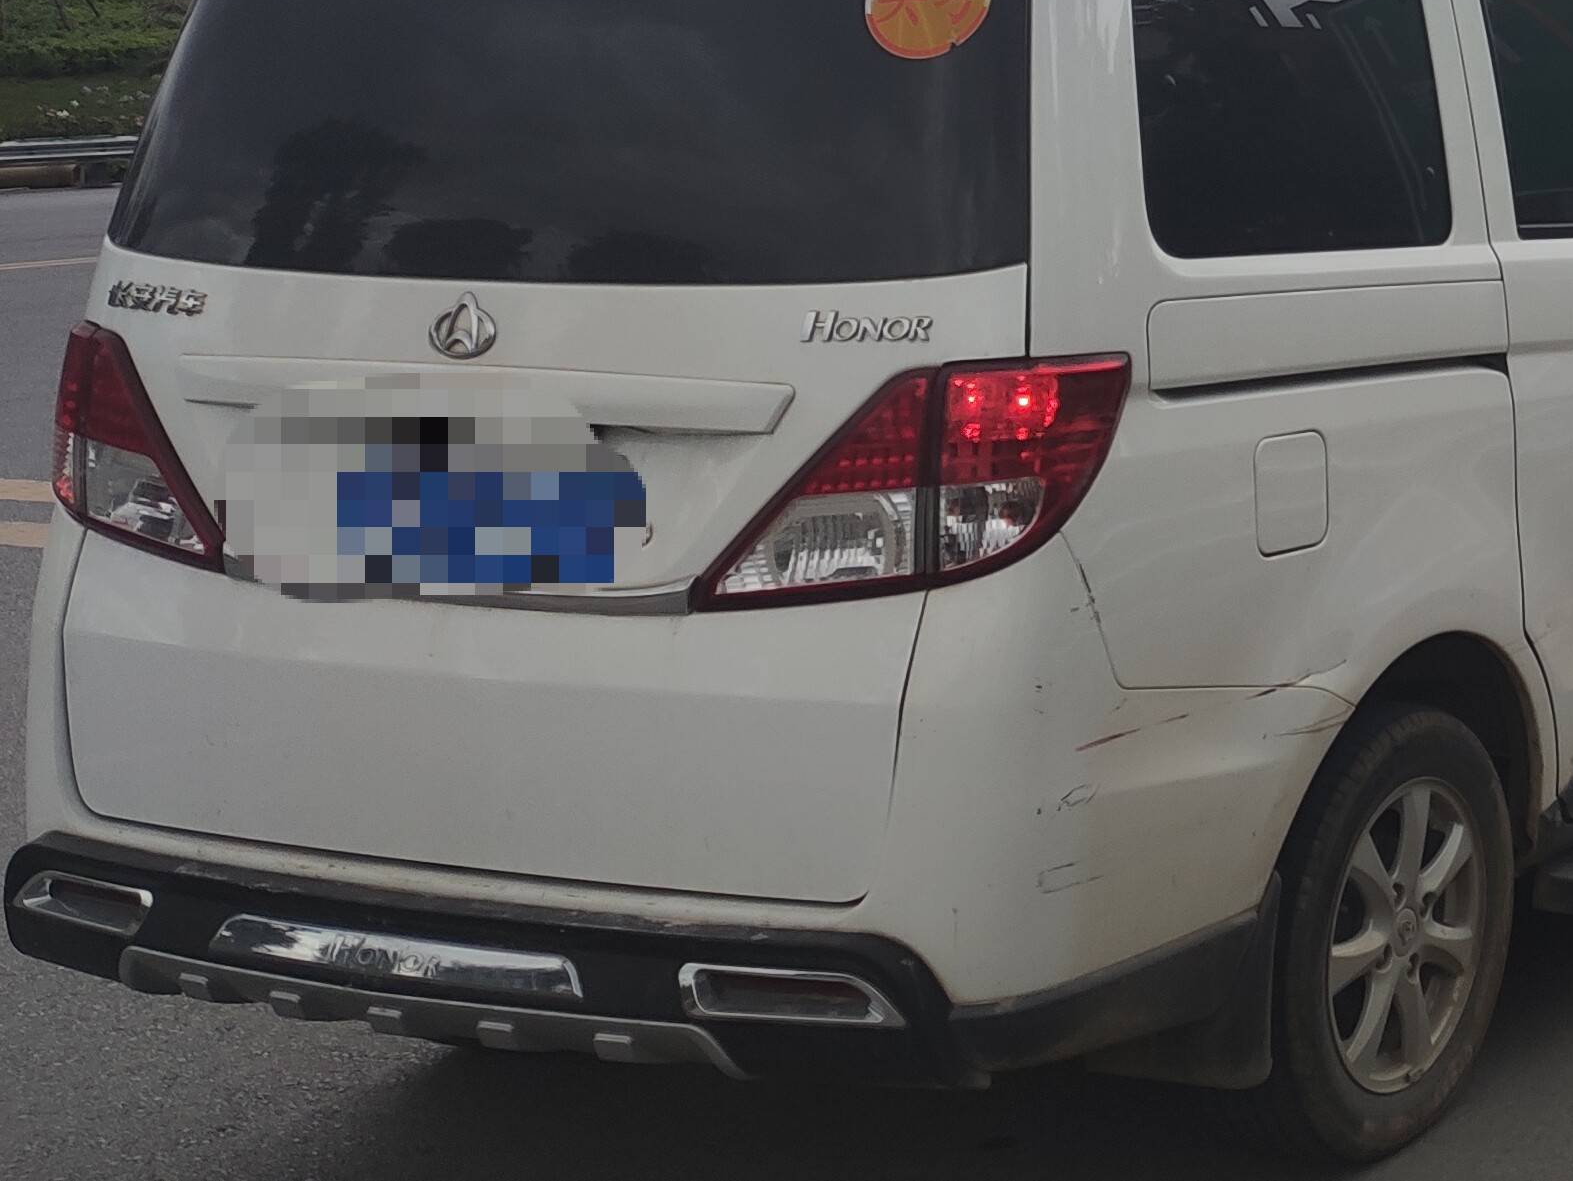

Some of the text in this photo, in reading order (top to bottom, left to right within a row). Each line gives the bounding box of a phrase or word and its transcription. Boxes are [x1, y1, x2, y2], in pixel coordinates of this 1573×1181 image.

[107, 280, 208, 317] 长安汽车
[799, 309, 934, 343] HONOR
